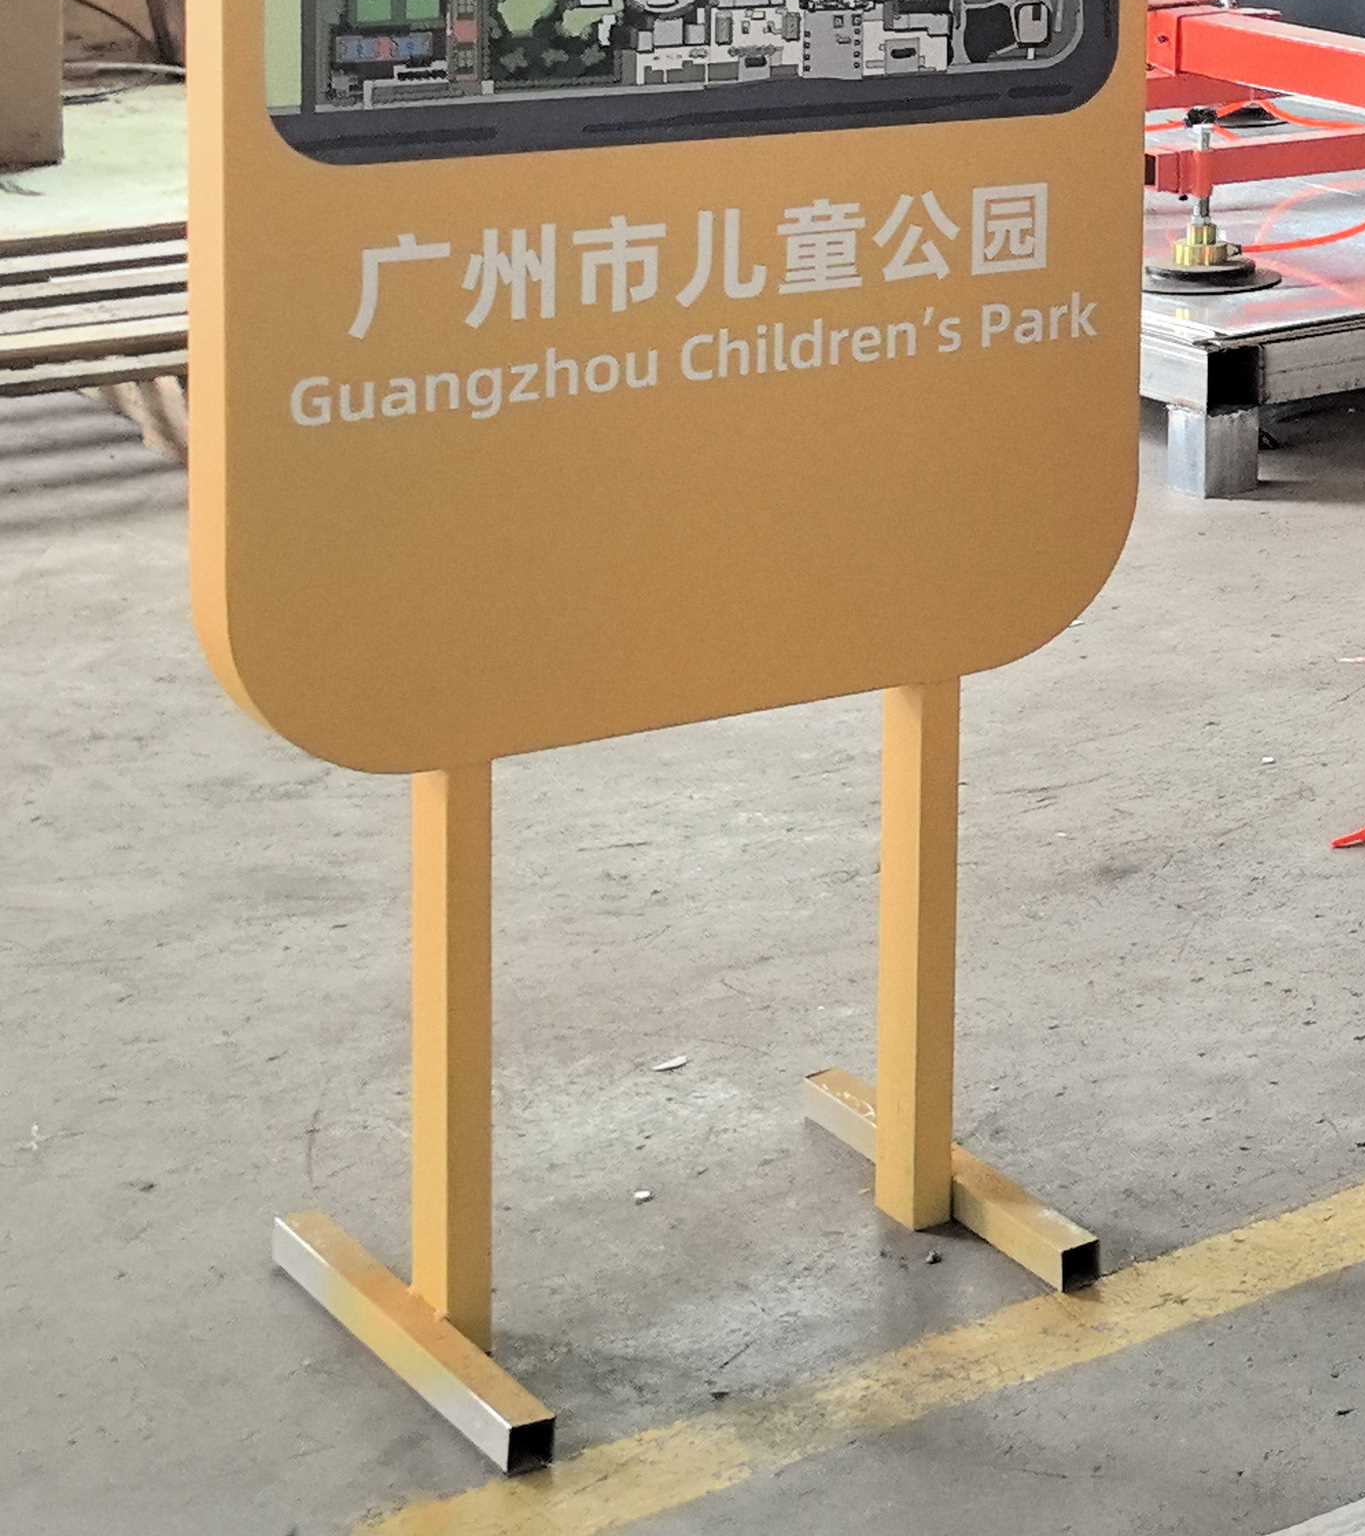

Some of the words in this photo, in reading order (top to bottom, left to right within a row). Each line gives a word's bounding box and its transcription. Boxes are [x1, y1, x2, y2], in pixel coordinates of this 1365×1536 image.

[348, 182, 1049, 340] 广州市儿童公园
[290, 346, 659, 427] Guangzhou
[680, 312, 962, 382] Children's
[981, 291, 1098, 348] Park
